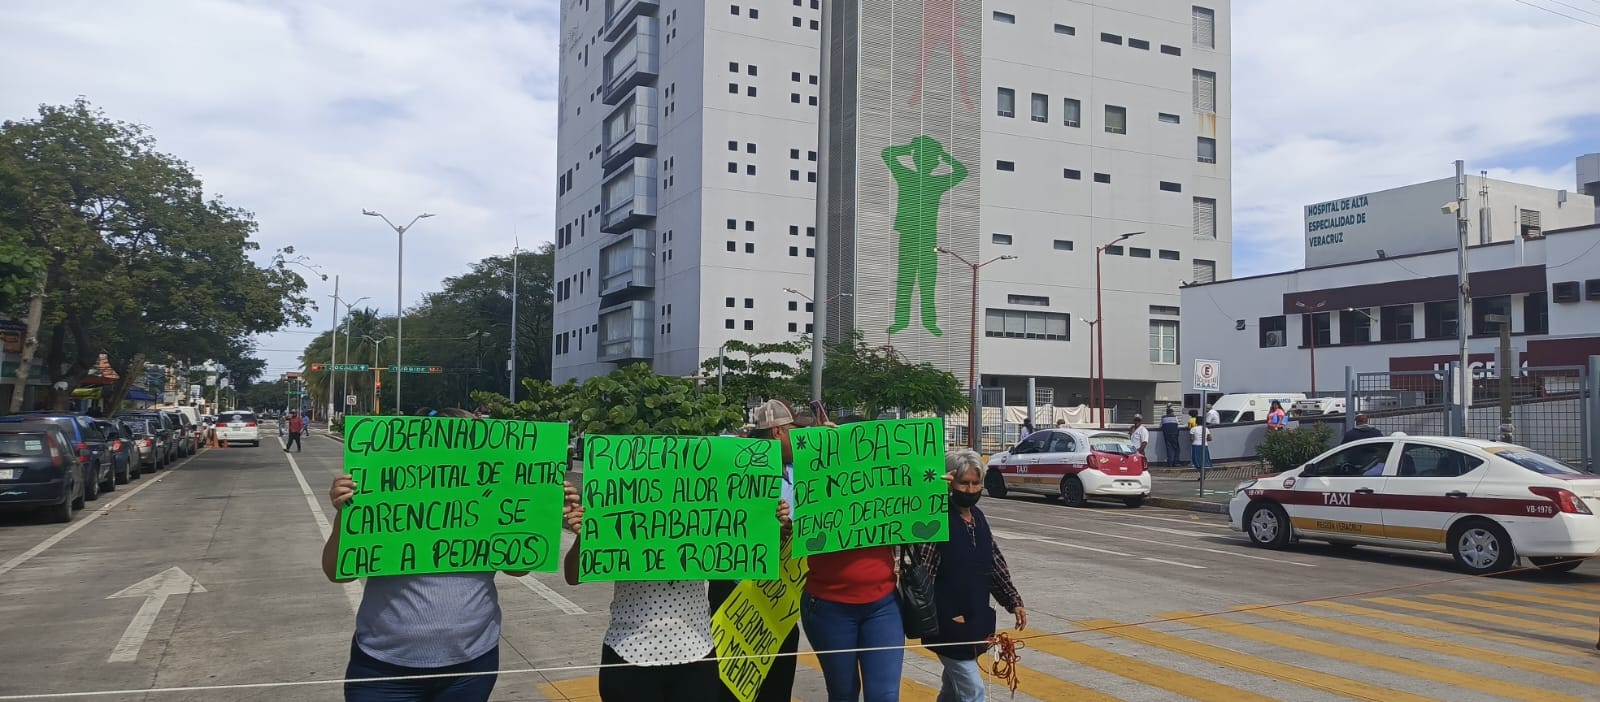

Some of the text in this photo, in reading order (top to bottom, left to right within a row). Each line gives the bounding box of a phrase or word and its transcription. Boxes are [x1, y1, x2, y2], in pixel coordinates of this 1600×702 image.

[1308, 196, 1369, 216] HOSPITAL DE ALTA
[1308, 212, 1366, 232] ESPECIALIDAD DE
[1309, 232, 1344, 247] VERACRUZ
[347, 417, 538, 457] GOBERNADORA
[849, 422, 937, 463] BASTA
[587, 436, 713, 472] ROBERTO
[1016, 465, 1028, 473] TAXI
[350, 461, 566, 496] EL HOSPITAL DE ALTAS
[585, 477, 664, 509] RAMOS
[672, 476, 720, 504] ALOR
[793, 463, 913, 510] DE MENTIR
[498, 498, 531, 527] SE
[1322, 492, 1351, 506] TAXI
[585, 508, 748, 541] A TRABAJAR
[793, 494, 949, 538] TENGO DERECHO DE
[838, 521, 906, 549] VIVIR
[340, 535, 541, 577] CAE A PEDASOS
[581, 548, 631, 577] DEJA
[642, 548, 666, 572] DE
[677, 542, 768, 574] ROBAR
[779, 600, 800, 622] Y
[724, 591, 778, 666] LAGRIMAS
